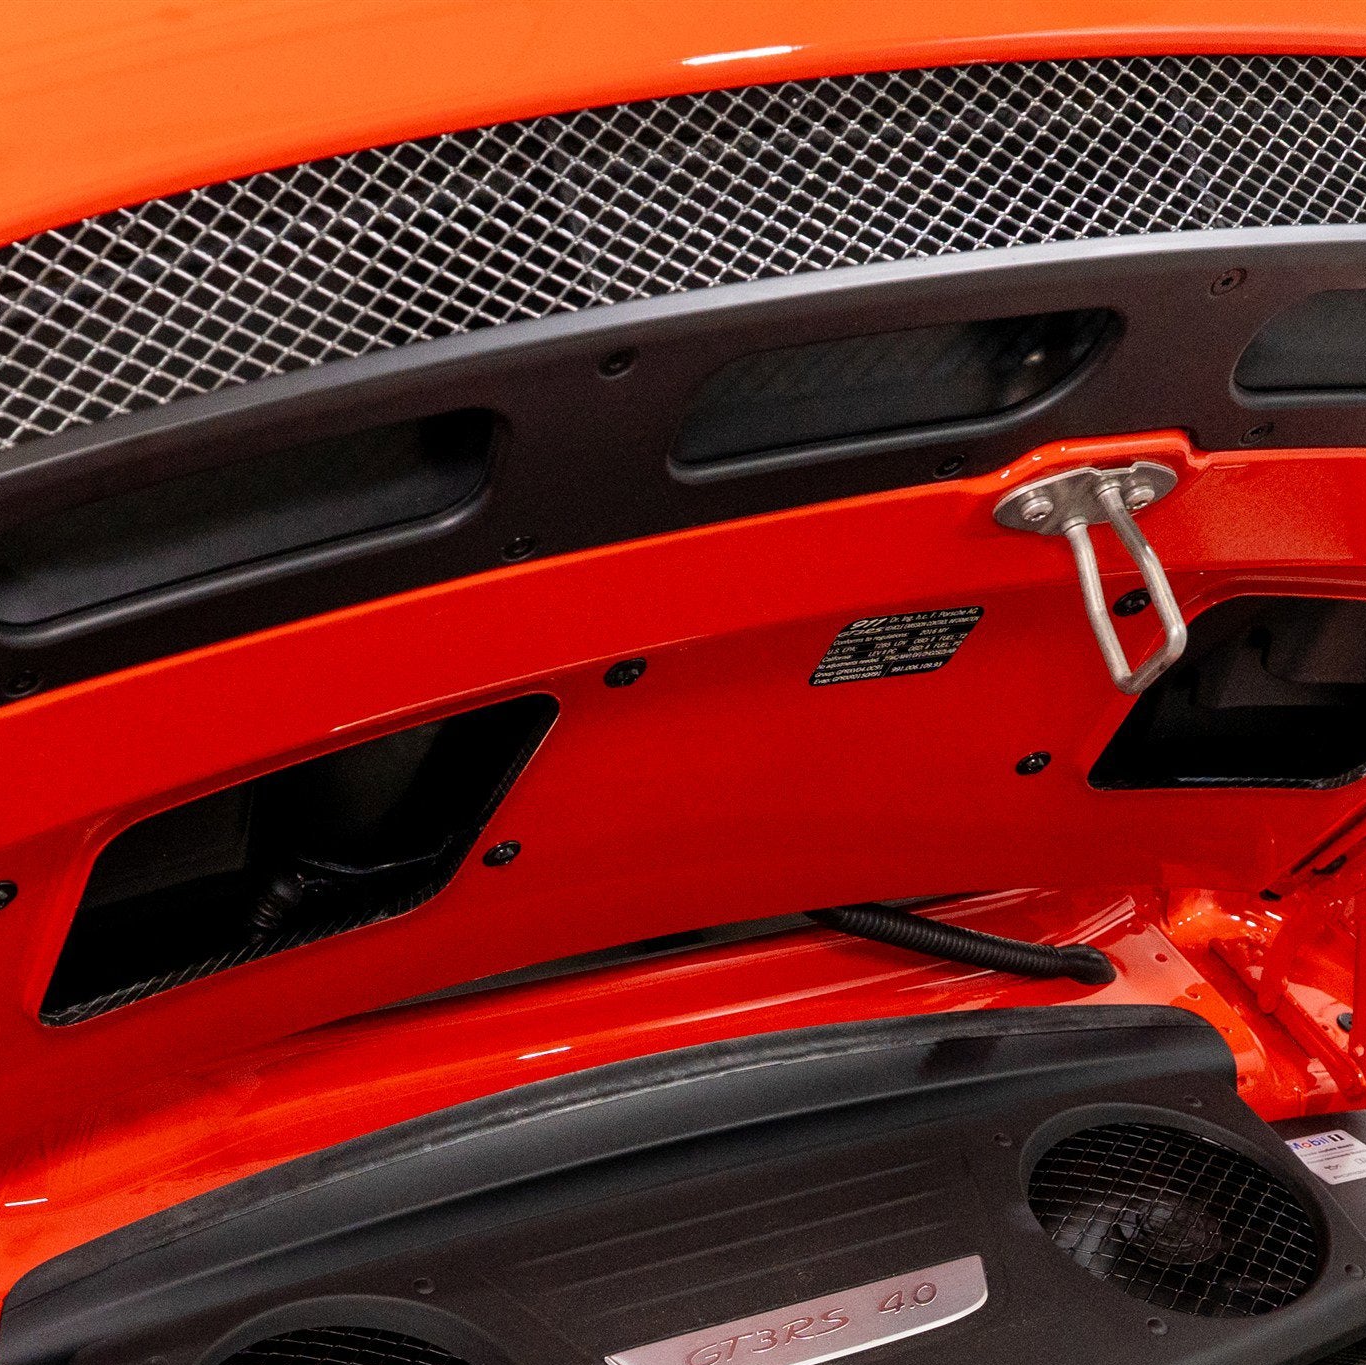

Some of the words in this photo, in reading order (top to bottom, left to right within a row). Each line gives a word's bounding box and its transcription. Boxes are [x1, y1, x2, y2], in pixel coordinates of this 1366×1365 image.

[938, 610, 966, 618] Porsche
[966, 607, 979, 615] AG
[850, 617, 888, 630] 911
[1292, 1136, 1329, 1152] Mobil
[878, 1281, 939, 1315] 4.0
